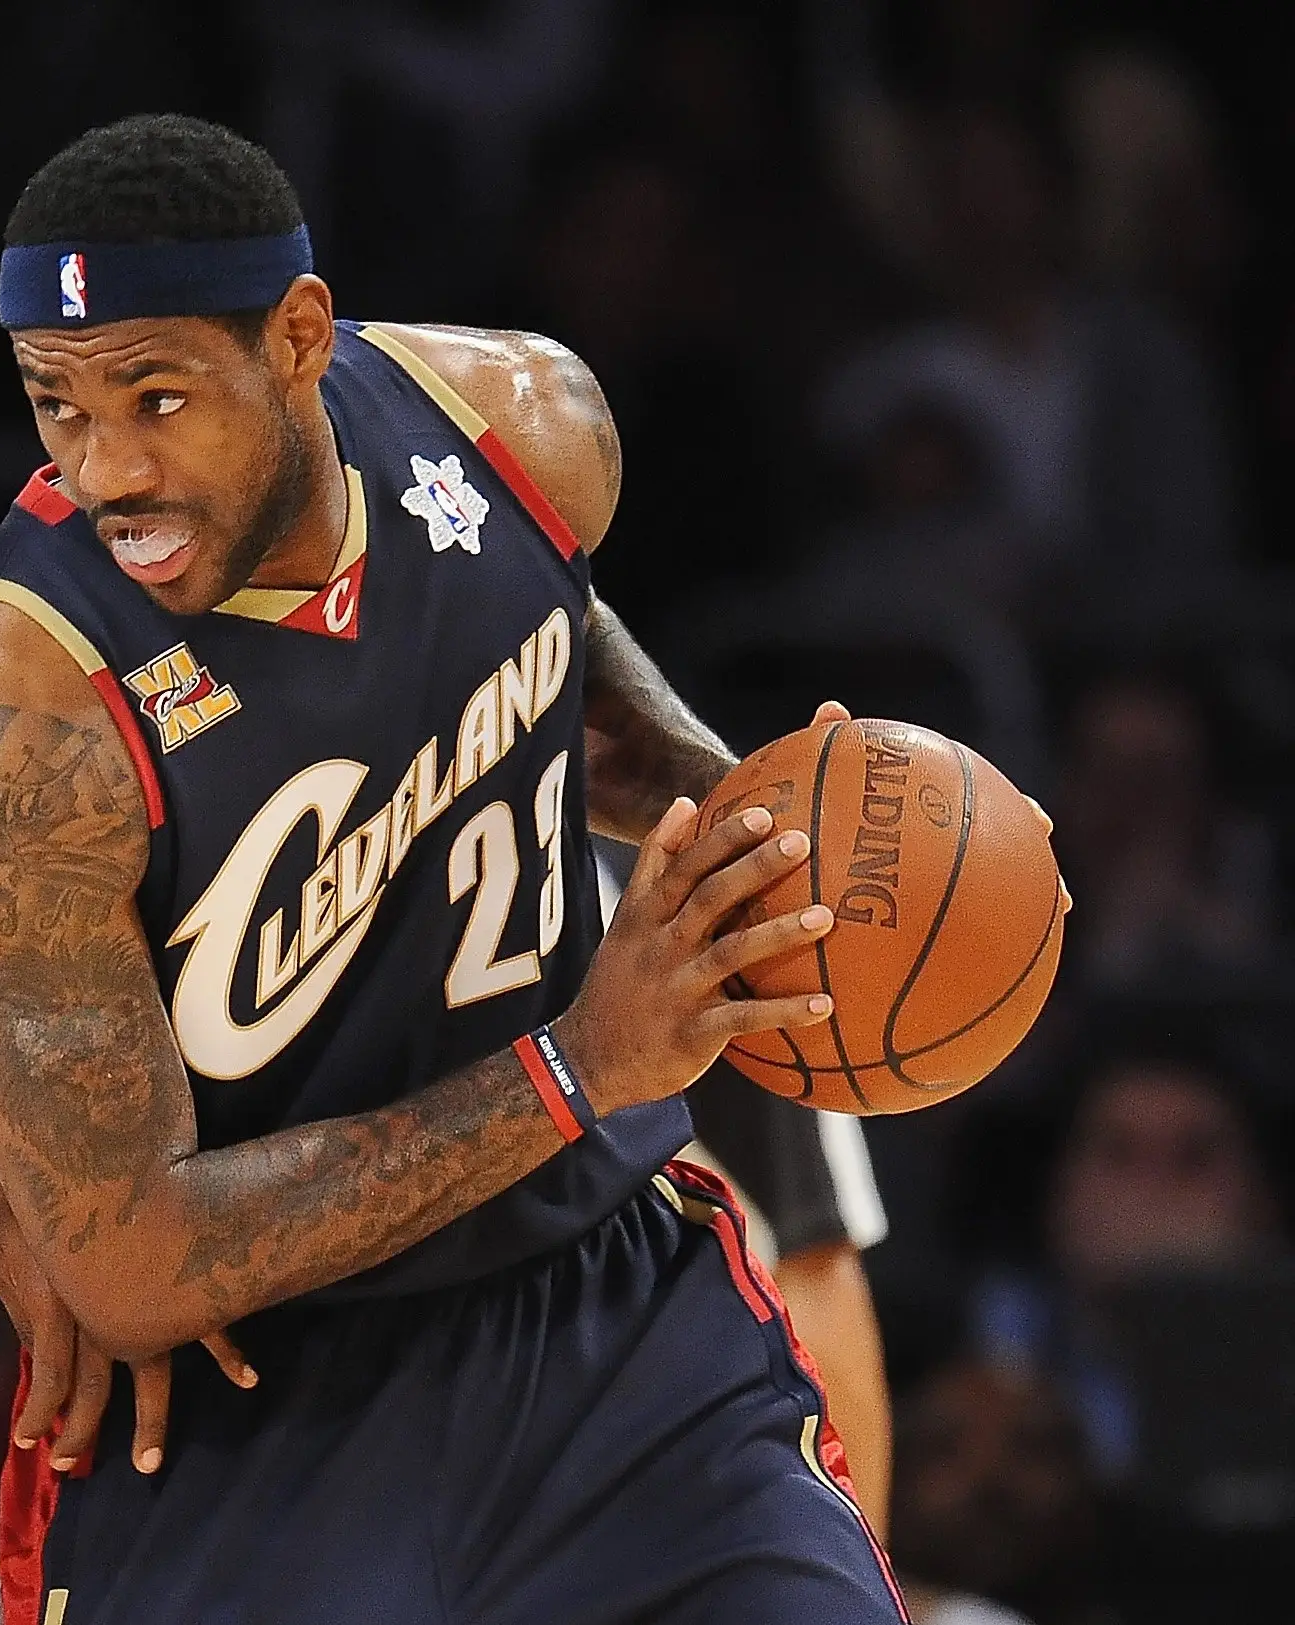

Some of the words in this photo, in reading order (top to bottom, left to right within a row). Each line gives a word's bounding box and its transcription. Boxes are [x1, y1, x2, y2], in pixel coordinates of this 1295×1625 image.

[321, 576, 355, 634] C
[165, 607, 571, 1080] CLEVELAND
[445, 750, 569, 1010] 23
